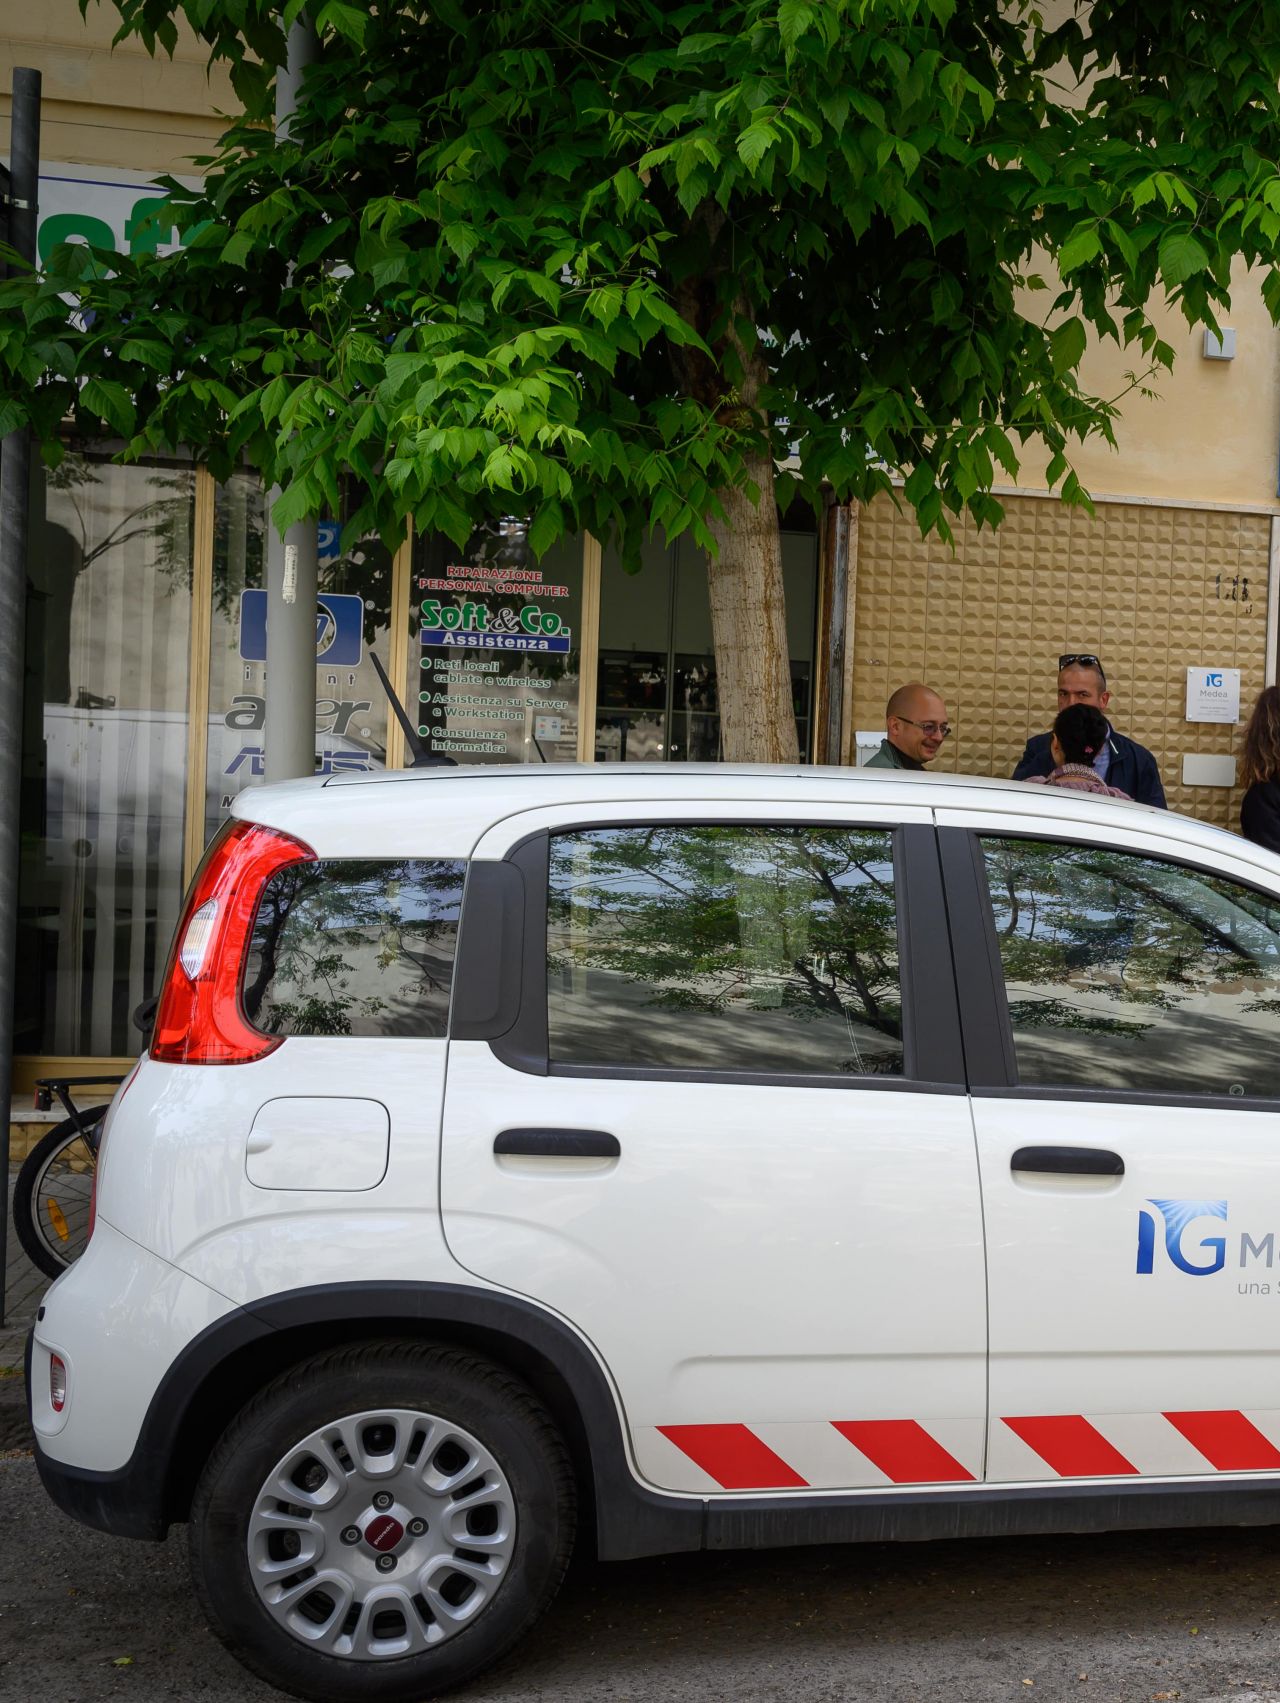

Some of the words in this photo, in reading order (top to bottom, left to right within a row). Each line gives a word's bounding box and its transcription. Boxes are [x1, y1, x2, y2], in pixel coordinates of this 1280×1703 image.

[446, 566, 543, 582] RIPARAZIONE
[419, 578, 492, 593] PERSONAL
[495, 583, 569, 597] COMPUTER
[442, 633, 550, 650] Assistenza
[434, 658, 461, 670] Reti
[464, 659, 500, 672] locali
[433, 673, 481, 685] cablate
[484, 675, 494, 686] e
[496, 676, 551, 688] wireless
[432, 693, 503, 706] Assistenza
[506, 698, 521, 707] su
[525, 697, 568, 709] Server
[1199, 690, 1228, 698] Medea
[224, 694, 372, 735] aer
[432, 707, 442, 717] e
[443, 706, 525, 720] Workstation
[431, 727, 507, 740] Consulenza
[431, 740, 507, 753] informatica
[1237, 1282, 1270, 1295] una
